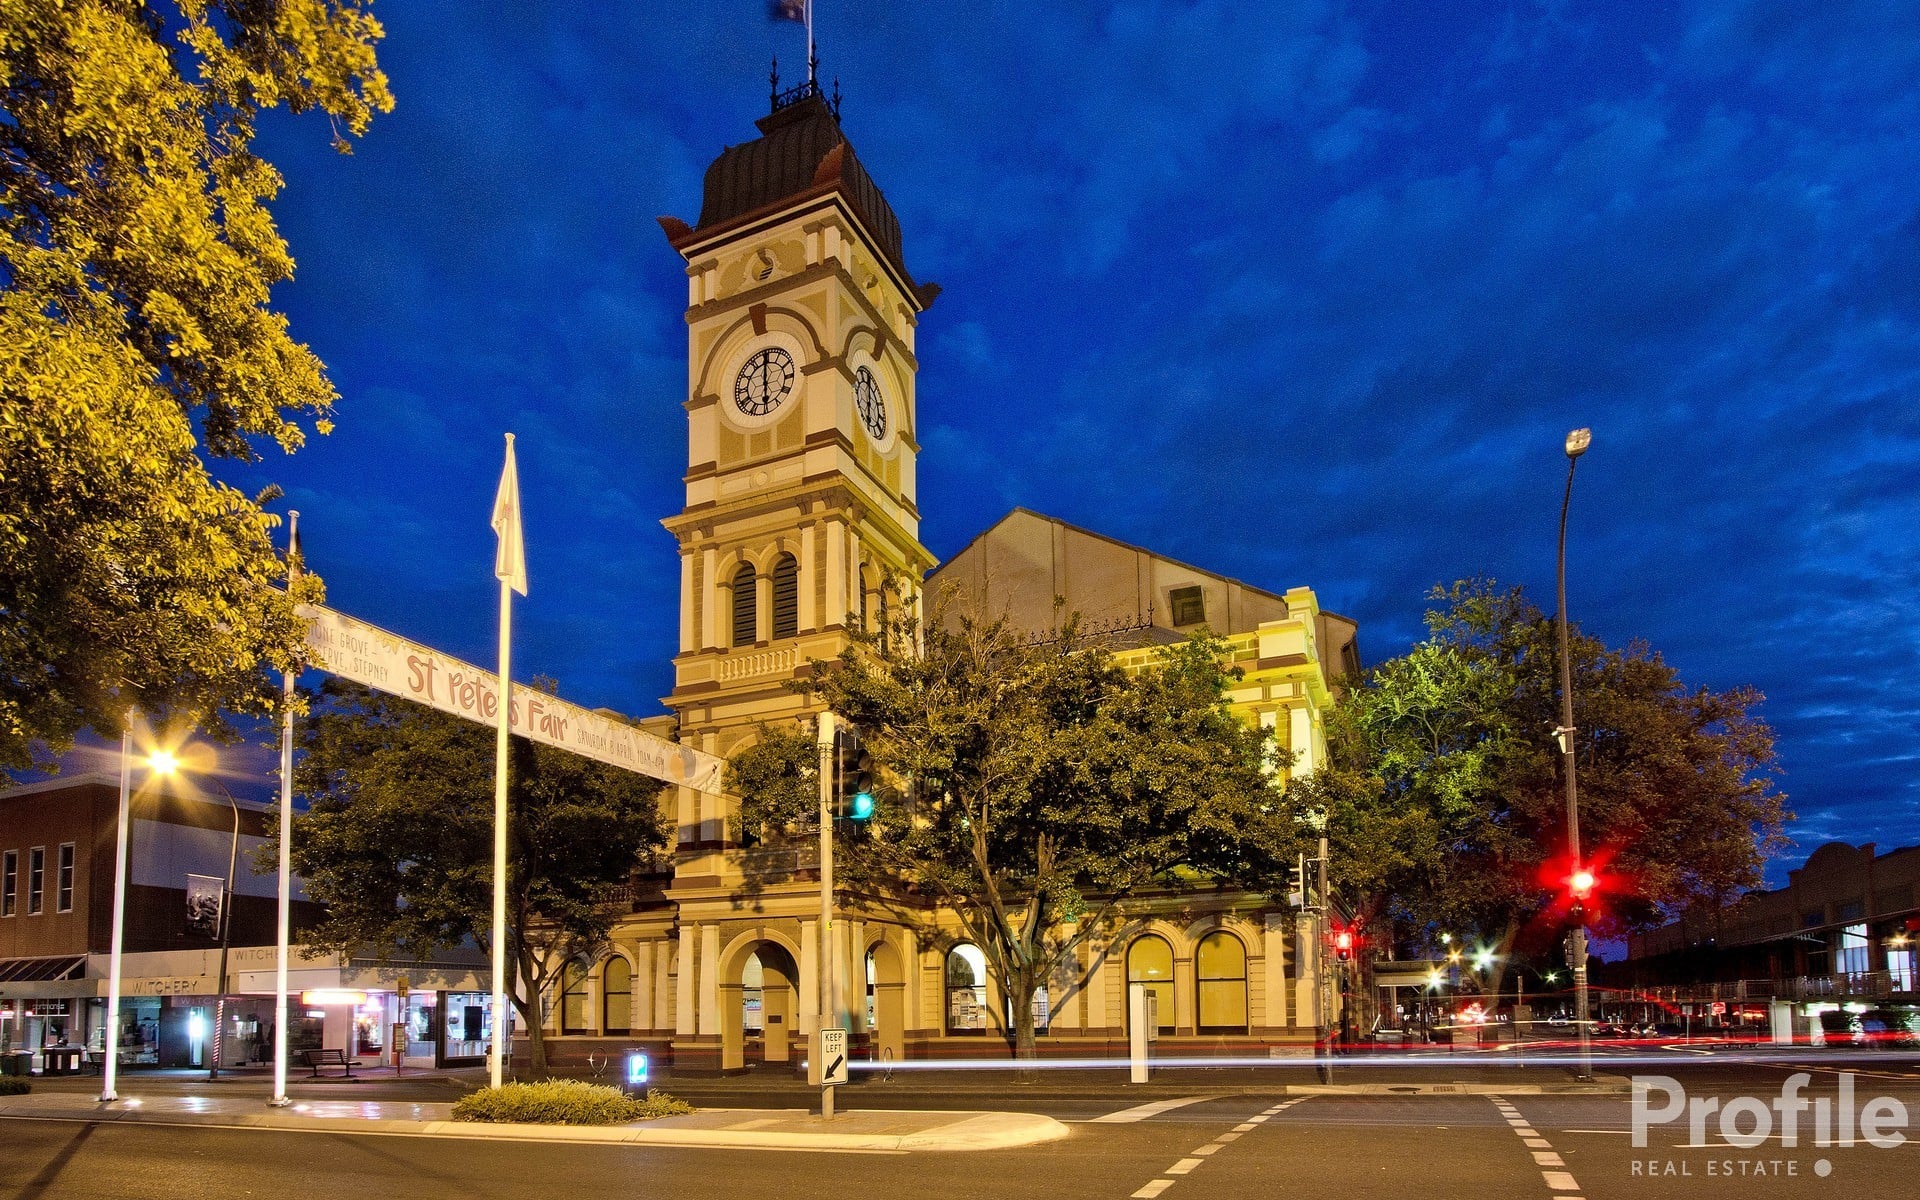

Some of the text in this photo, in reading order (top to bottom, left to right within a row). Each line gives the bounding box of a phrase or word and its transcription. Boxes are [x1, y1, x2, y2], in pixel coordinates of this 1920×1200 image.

[340, 632, 368, 657] GROVE
[354, 657, 388, 682] STEPNEY
[407, 655, 568, 741] St Petes Fair
[577, 728, 607, 752] SATURDAY
[132, 980, 198, 994] WITCHERY
[825, 1033, 843, 1042] KEEP
[826, 1044, 842, 1053] LEFT
